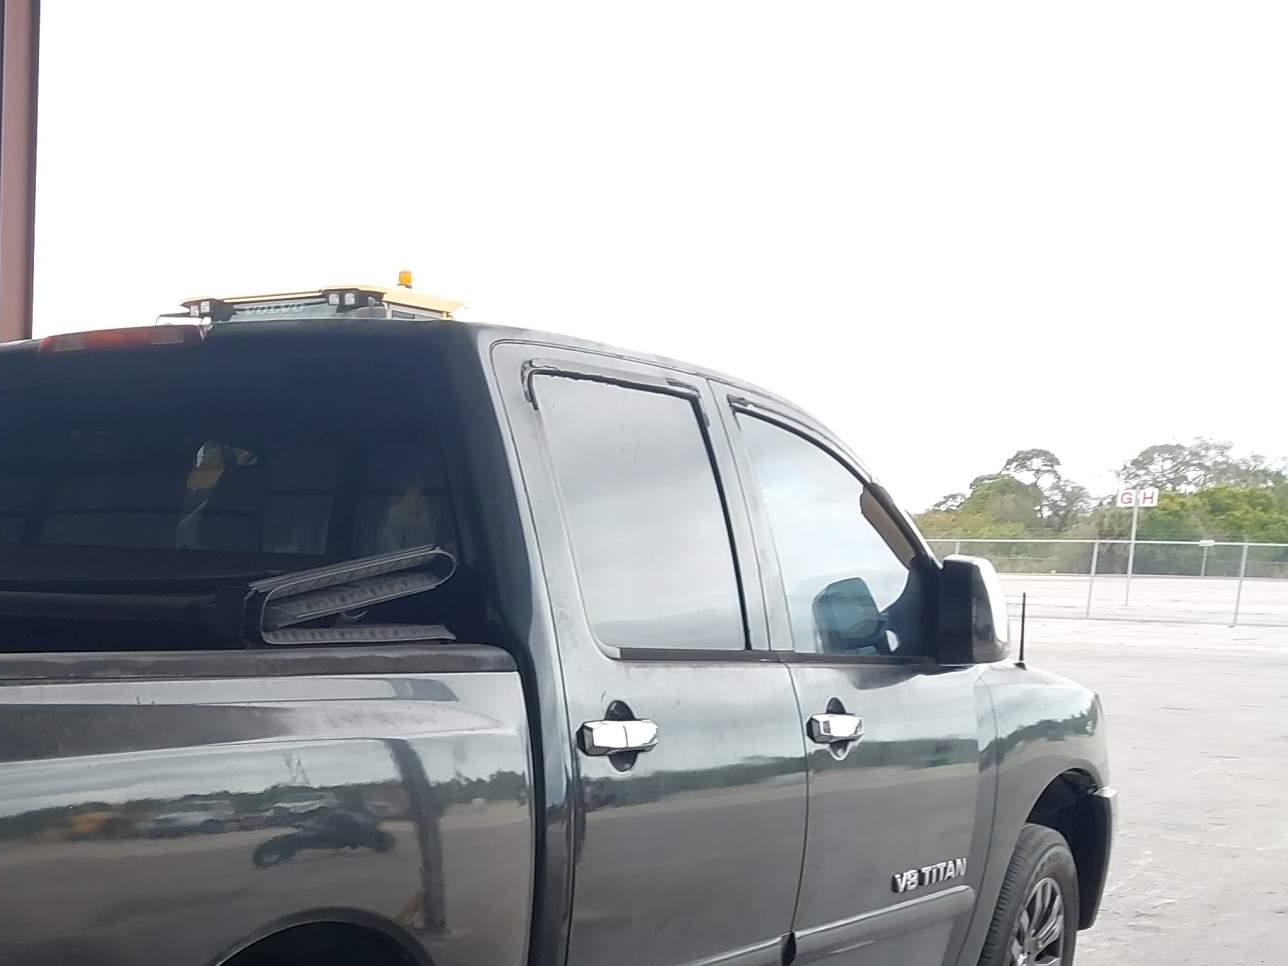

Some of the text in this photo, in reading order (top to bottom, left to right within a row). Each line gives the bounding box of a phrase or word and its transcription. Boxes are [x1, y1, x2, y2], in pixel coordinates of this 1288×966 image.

[1120, 492, 1133, 504] G
[1142, 491, 1155, 504] H
[892, 857, 967, 893] V8 TITAN
